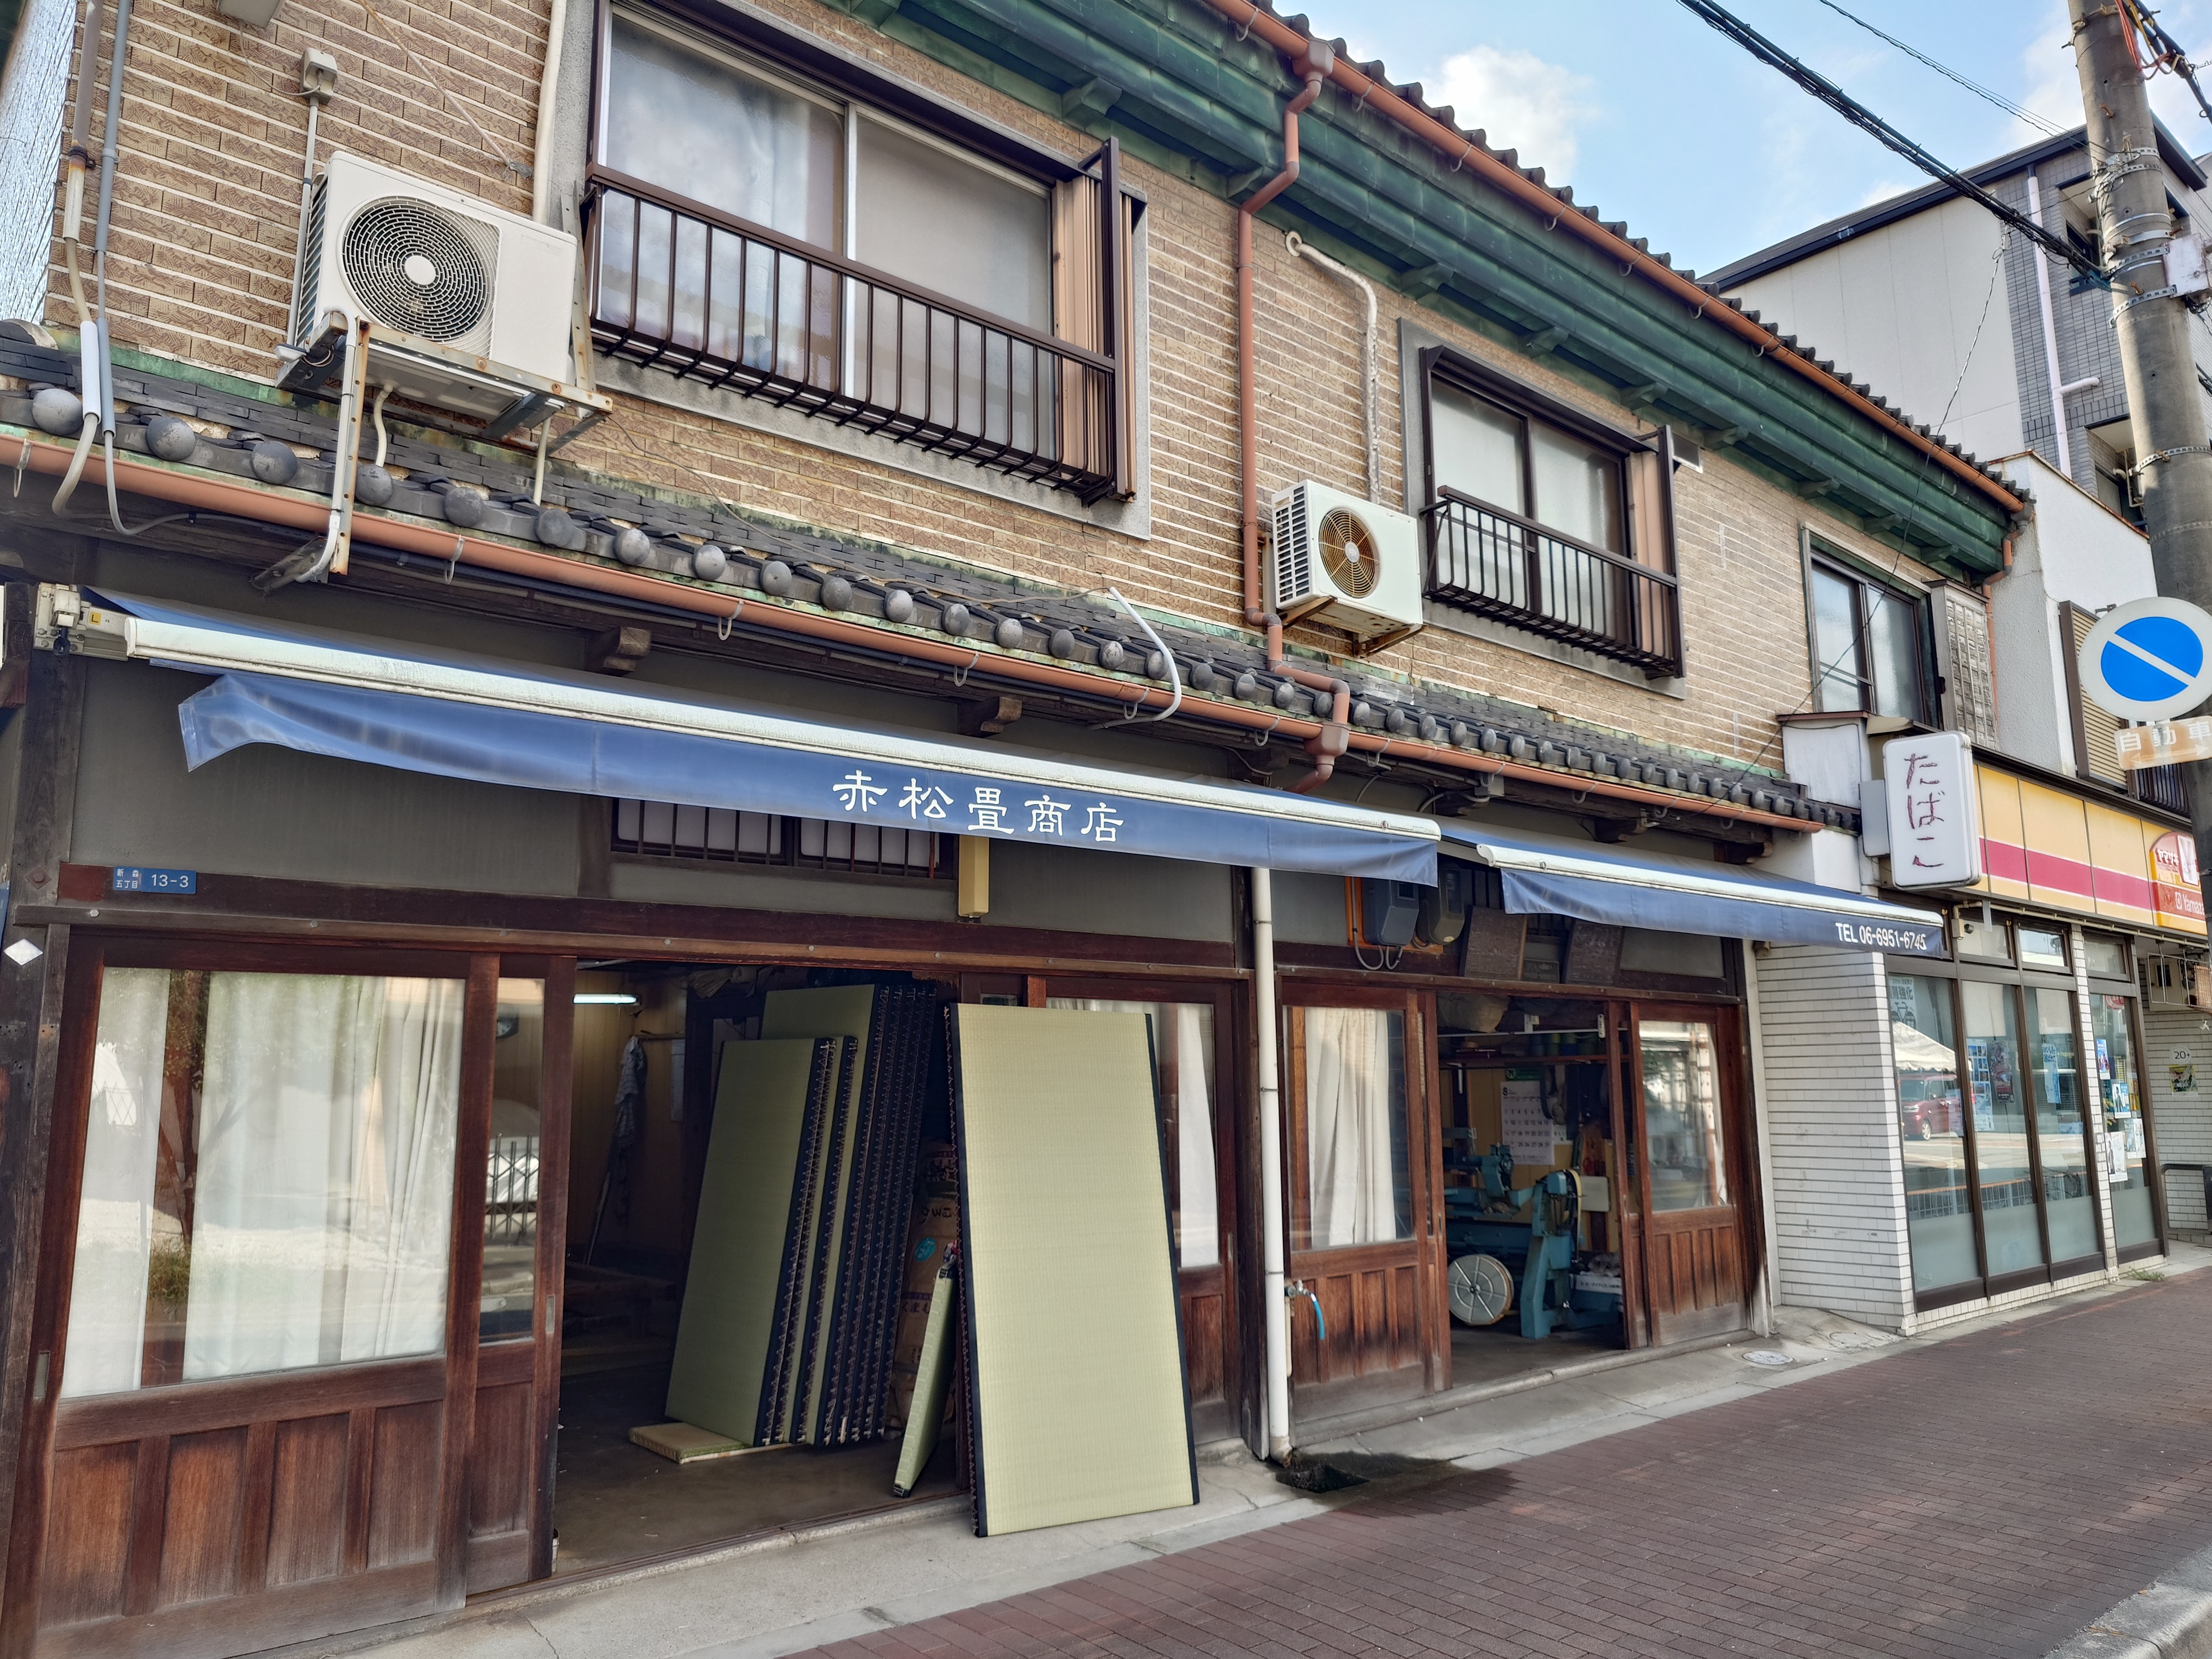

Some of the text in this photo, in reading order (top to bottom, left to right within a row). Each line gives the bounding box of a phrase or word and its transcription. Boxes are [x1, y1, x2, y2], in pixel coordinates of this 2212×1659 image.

[91, 614, 98, 623] L
[2119, 721, 2212, 752] 自動車
[832, 769, 1124, 843] 赤松畳商店
[1903, 753, 1945, 868] たばこ
[116, 868, 139, 878] 新森
[115, 879, 138, 889] 五丁目
[151, 874, 189, 888] 13-3
[1835, 922, 1928, 951] TEL 06-6951-6745
[2173, 1051, 2190, 1060] 20+
[1503, 1087, 1508, 1096] 8
